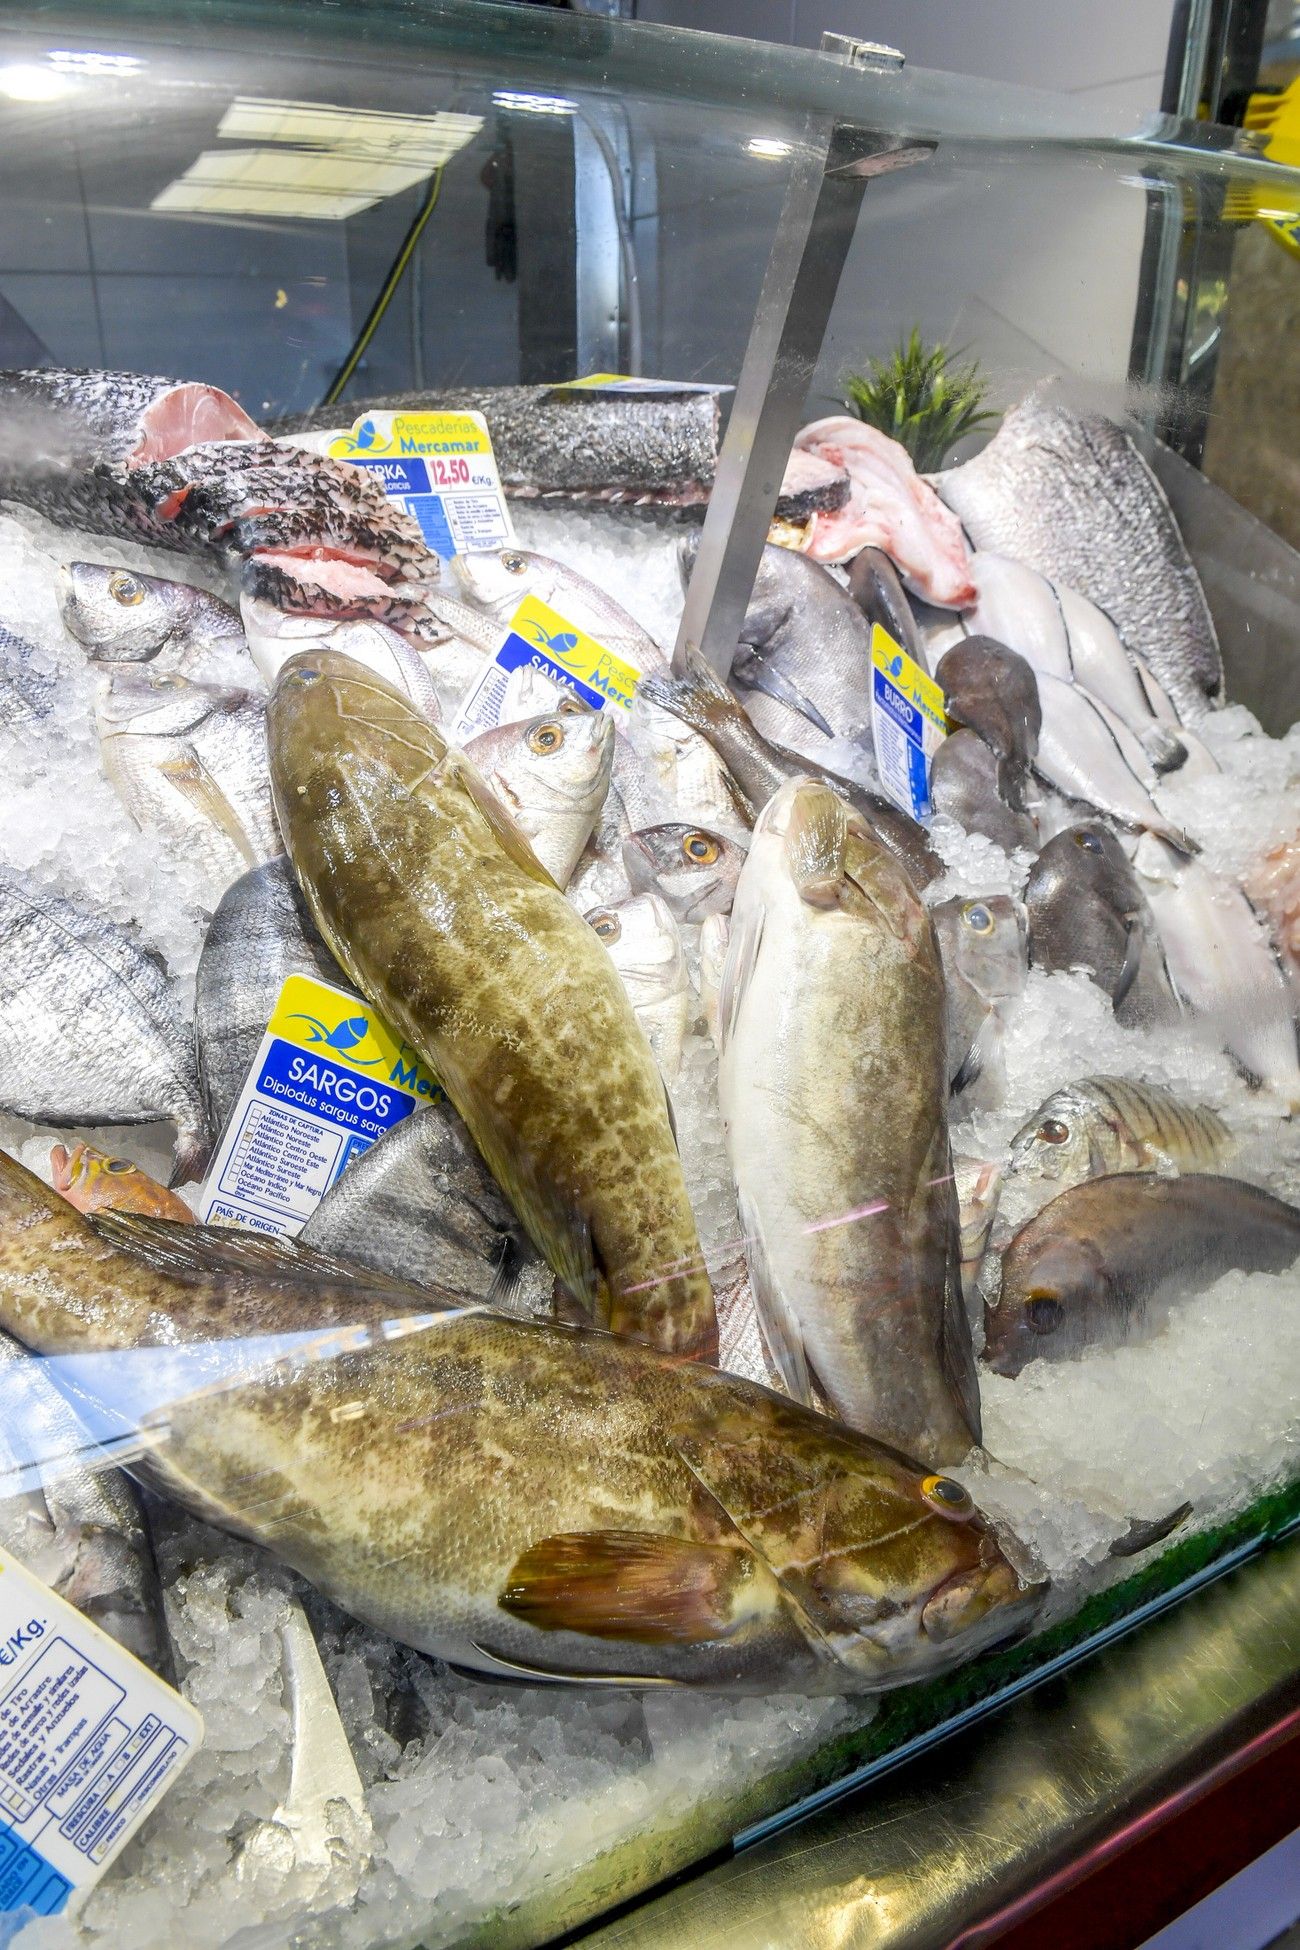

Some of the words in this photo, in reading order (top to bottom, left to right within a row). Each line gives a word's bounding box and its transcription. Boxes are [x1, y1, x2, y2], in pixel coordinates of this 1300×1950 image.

[394, 417, 477, 435] Pescaderías
[400, 436, 480, 454] Mercamar
[430, 458, 470, 485] 12,50
[884, 683, 914, 724] BURRO
[263, 1075, 317, 1107] Diplodus
[319, 1101, 359, 1125] sargus
[288, 1058, 391, 1117] SARGOS
[260, 1114, 290, 1131] Atlántico
[290, 1126, 320, 1144] Noroeste
[268, 1109, 289, 1121] ZONAS
[288, 1117, 298, 1125] DE
[297, 1121, 324, 1136] CAPTURA
[251, 1138, 281, 1154] Atlántico
[282, 1149, 305, 1164] Centro
[305, 1158, 320, 1170] Este
[254, 1130, 284, 1146] Atlántico
[285, 1141, 308, 1156] Centro
[308, 1151, 328, 1164] Oeste
[285, 1133, 312, 1149] Noreste
[240, 1169, 266, 1184] Océano
[245, 1154, 275, 1170] Atlántico
[276, 1165, 301, 1180] Sureste
[248, 1146, 278, 1162] Atlántico
[279, 1157, 308, 1174] Suroeste
[237, 1177, 263, 1192] Océano
[243, 1161, 254, 1171] Mar
[254, 1166, 289, 1184] Mediterráneo
[289, 1180, 295, 1188] y
[294, 1180, 305, 1190] Mar
[305, 1185, 322, 1197] Negro
[215, 1205, 234, 1219] PAÍS
[234, 1212, 248, 1224] DE
[249, 1218, 280, 1235] ORIGEN
[0, 1619, 47, 1666] €/Kg.
[9, 1688, 28, 1706] Tiro
[9, 1715, 19, 1728] de
[19, 1676, 52, 1715] Arrastre
[11, 1730, 21, 1741] de
[43, 1696, 50, 1704] y
[48, 1665, 75, 1696] similares
[20, 1737, 29, 1748] de
[28, 1716, 47, 1738] cerco
[46, 1709, 53, 1717] y
[51, 1688, 70, 1709] redes
[7, 1743, 39, 1779] Sedales
[38, 1735, 46, 1744] y
[45, 1693, 80, 1734] Anzuelos
[15, 1751, 47, 1786] Rastras
[24, 1765, 50, 1794] Nasas
[48, 1756, 57, 1766] y
[54, 1718, 88, 1754] Trampas
[57, 1772, 80, 1798] MASA
[78, 1756, 92, 1771] DE
[90, 1733, 111, 1757] AGUA
[33, 1774, 58, 1801] Otras
[65, 1793, 100, 1833] FRESCURA
[106, 1773, 115, 1782] A
[122, 1752, 131, 1761] B
[139, 1721, 154, 1739] EXT
[79, 1808, 111, 1847] CALIBRE
[105, 1818, 126, 1843] FRESCO
